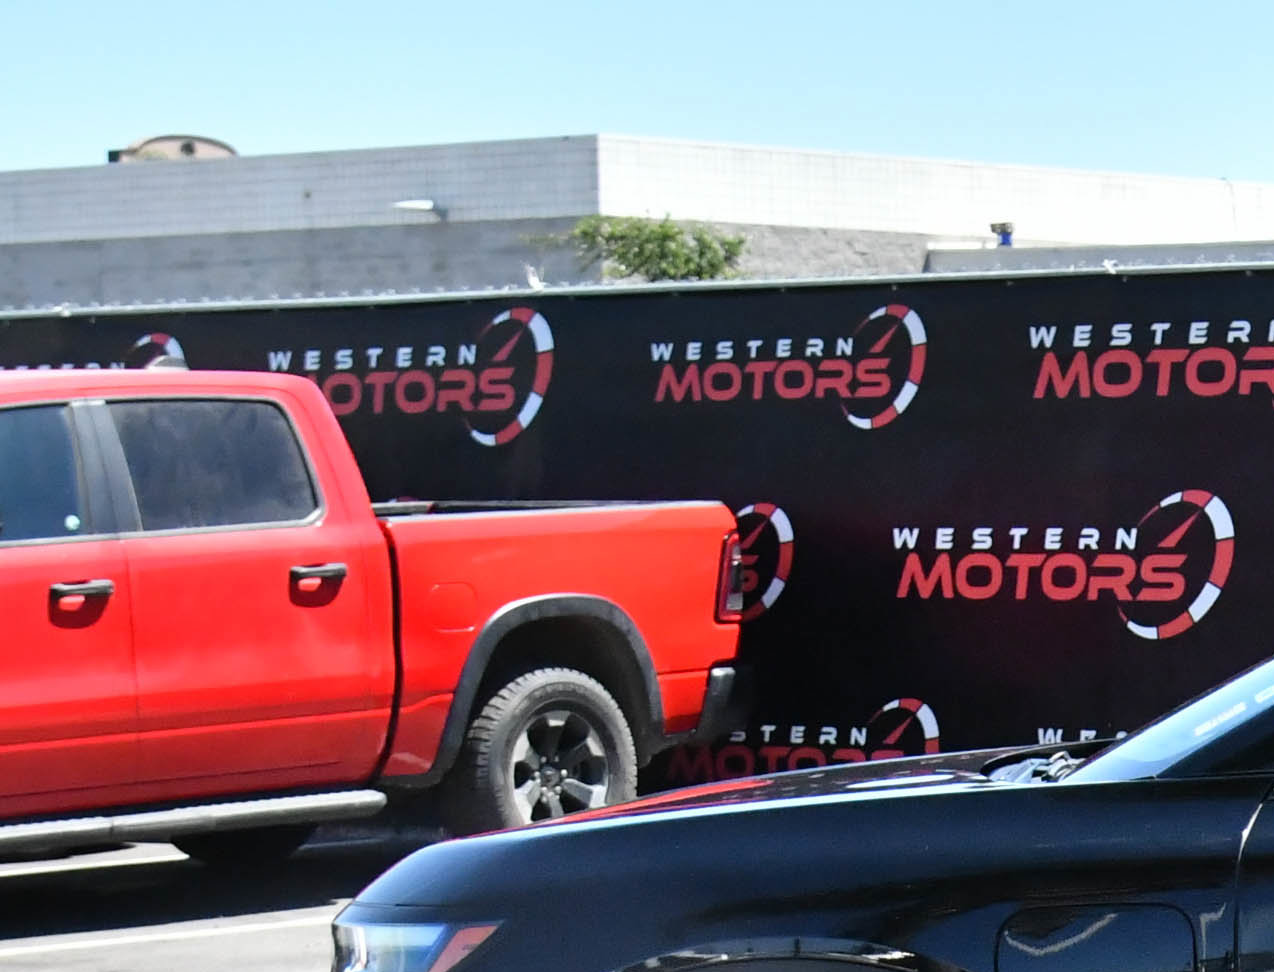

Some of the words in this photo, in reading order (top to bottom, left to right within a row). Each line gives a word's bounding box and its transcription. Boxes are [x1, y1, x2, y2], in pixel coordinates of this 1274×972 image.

[267, 344, 477, 371] WESTERN
[651, 337, 853, 361] WESTERN
[306, 366, 516, 416] OTORS
[655, 357, 892, 403] MOTORS
[893, 527, 1137, 550] WESTERN
[896, 552, 1188, 601] MOTORS
